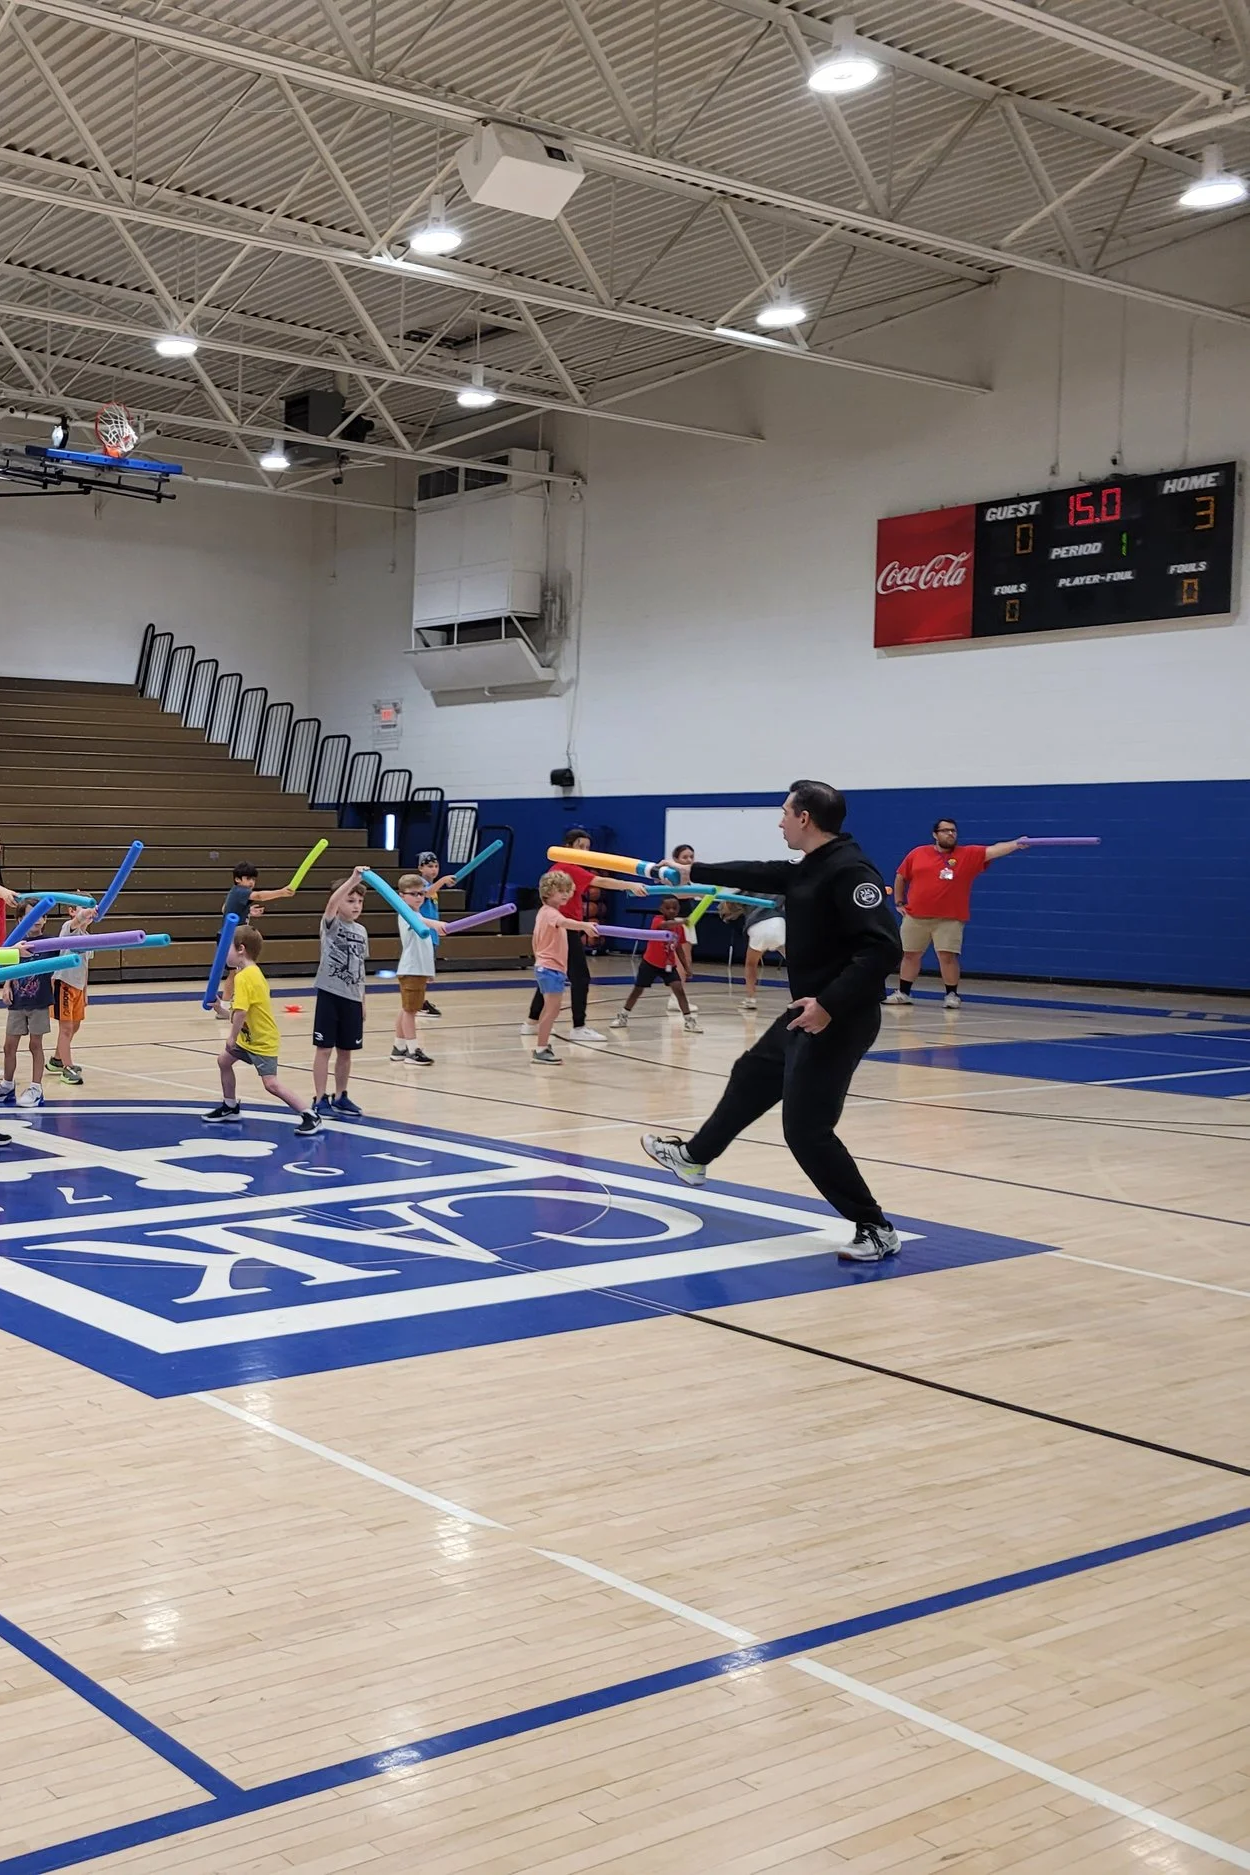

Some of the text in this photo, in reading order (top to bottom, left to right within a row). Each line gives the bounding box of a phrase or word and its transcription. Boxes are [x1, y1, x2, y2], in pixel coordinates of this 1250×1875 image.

[1162, 472, 1221, 494] HOME
[985, 501, 1041, 521] GUEST
[1068, 487, 1122, 527] 15.0
[1194, 495, 1215, 530] 3
[1050, 542, 1103, 559] PERIOD
[876, 551, 972, 595] Coca-Cola
[1168, 561, 1207, 575] FOULS
[993, 583, 1027, 595] FOULS
[1058, 570, 1134, 588] PLAYER-FOUL
[24, 1189, 704, 1304] CAK
